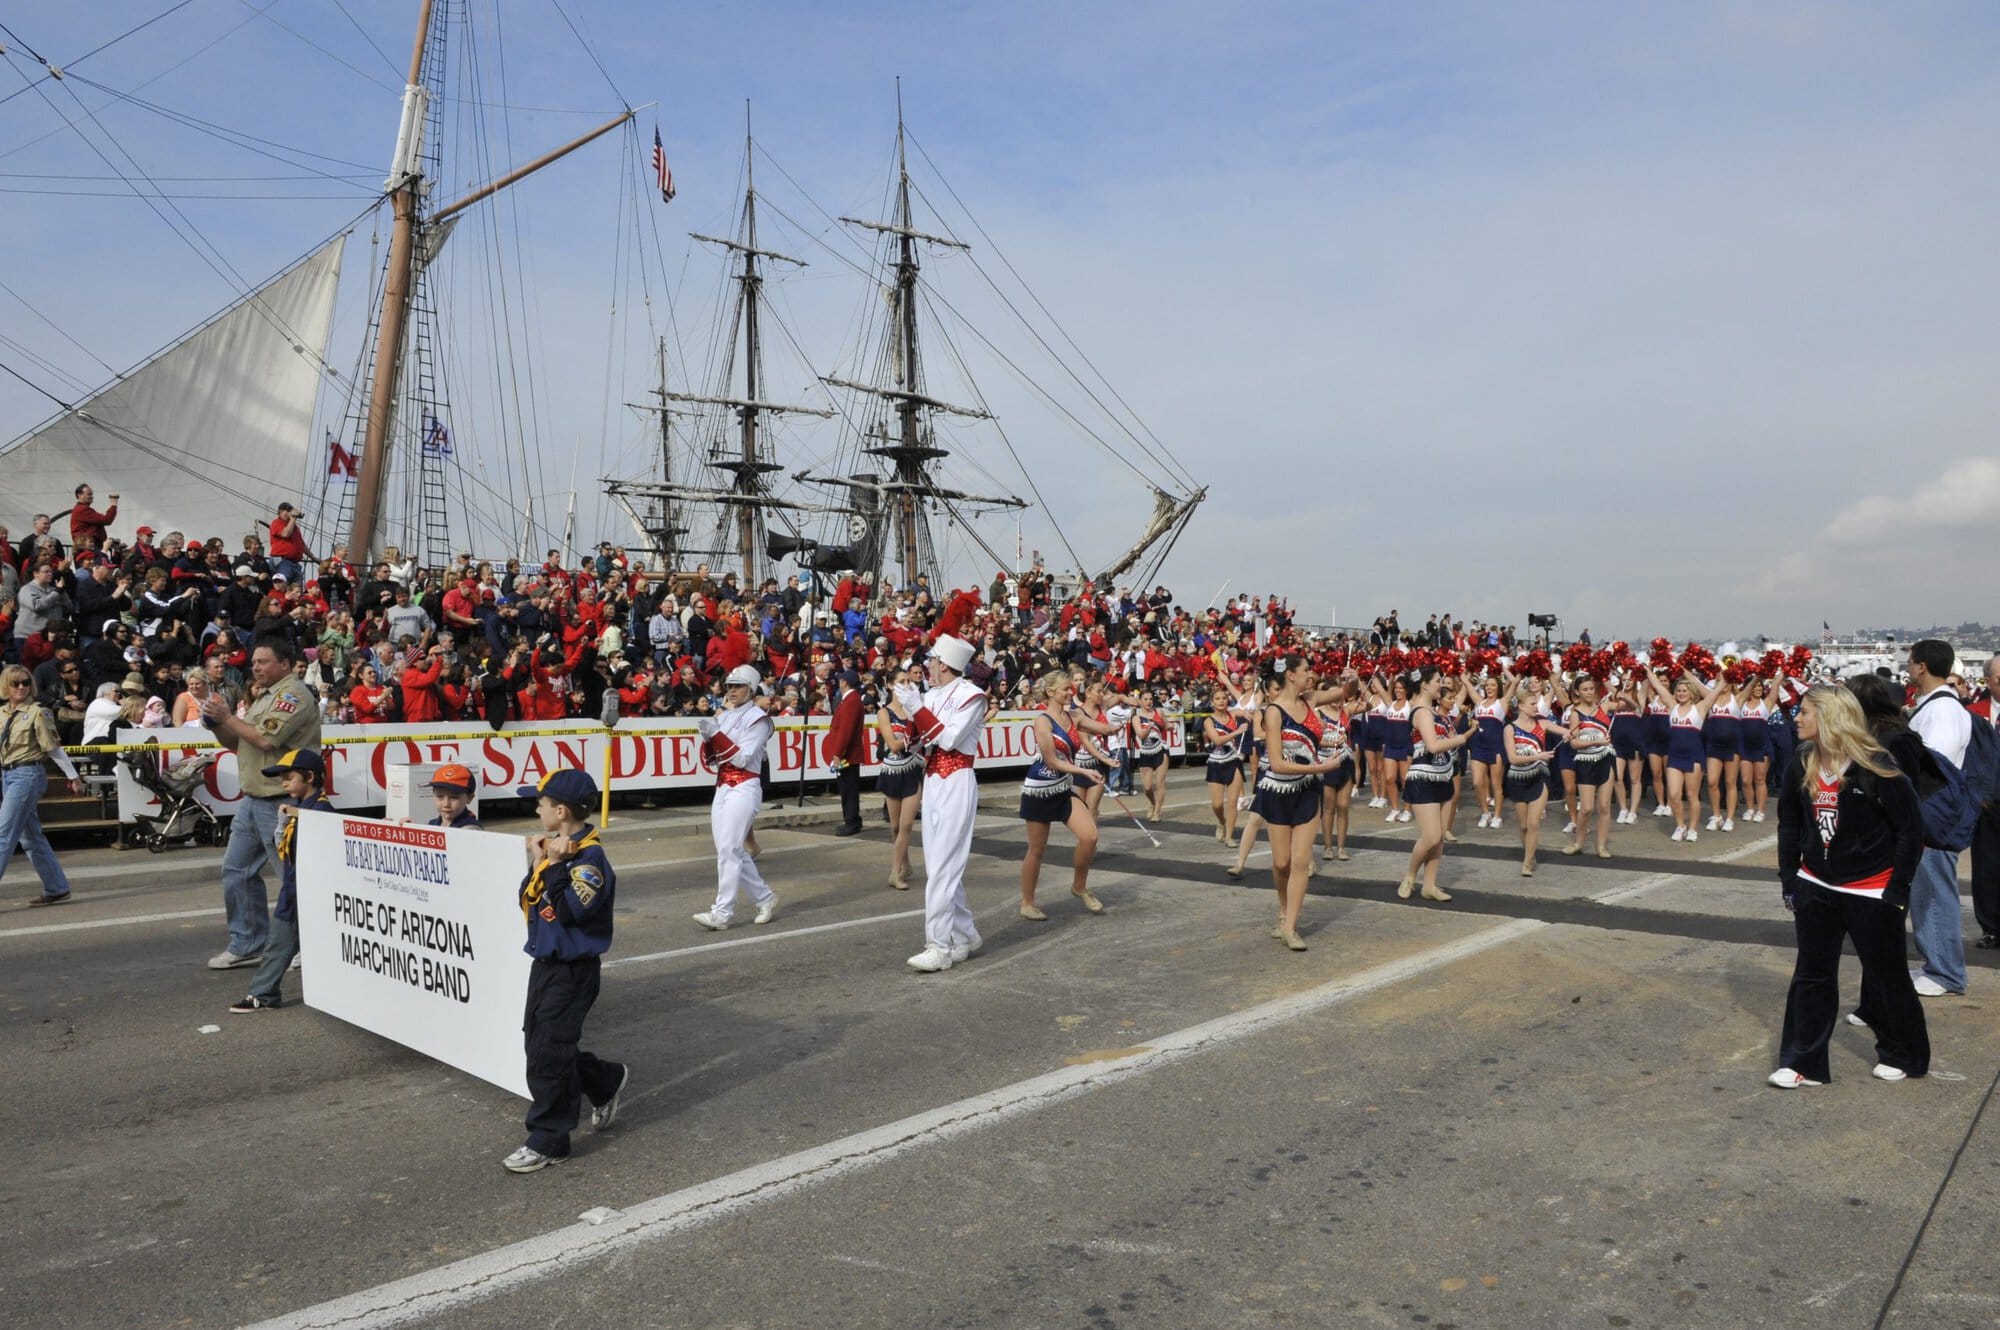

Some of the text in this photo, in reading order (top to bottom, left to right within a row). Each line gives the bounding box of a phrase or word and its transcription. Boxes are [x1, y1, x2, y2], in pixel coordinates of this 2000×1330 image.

[123, 744, 160, 752] CAUTION
[180, 742, 216, 750] CAUTION
[336, 737, 367, 745] CAUTION
[383, 735, 412, 743] CAUTION
[482, 735, 589, 787] SAN
[344, 822, 445, 847] PORT OF SAN DIEGO
[344, 839, 450, 886] BIG BAY BALLOON PARADE
[334, 892, 475, 962] PRIDE OF ARIZONA
[341, 932, 471, 1004] MARCHING BAND
